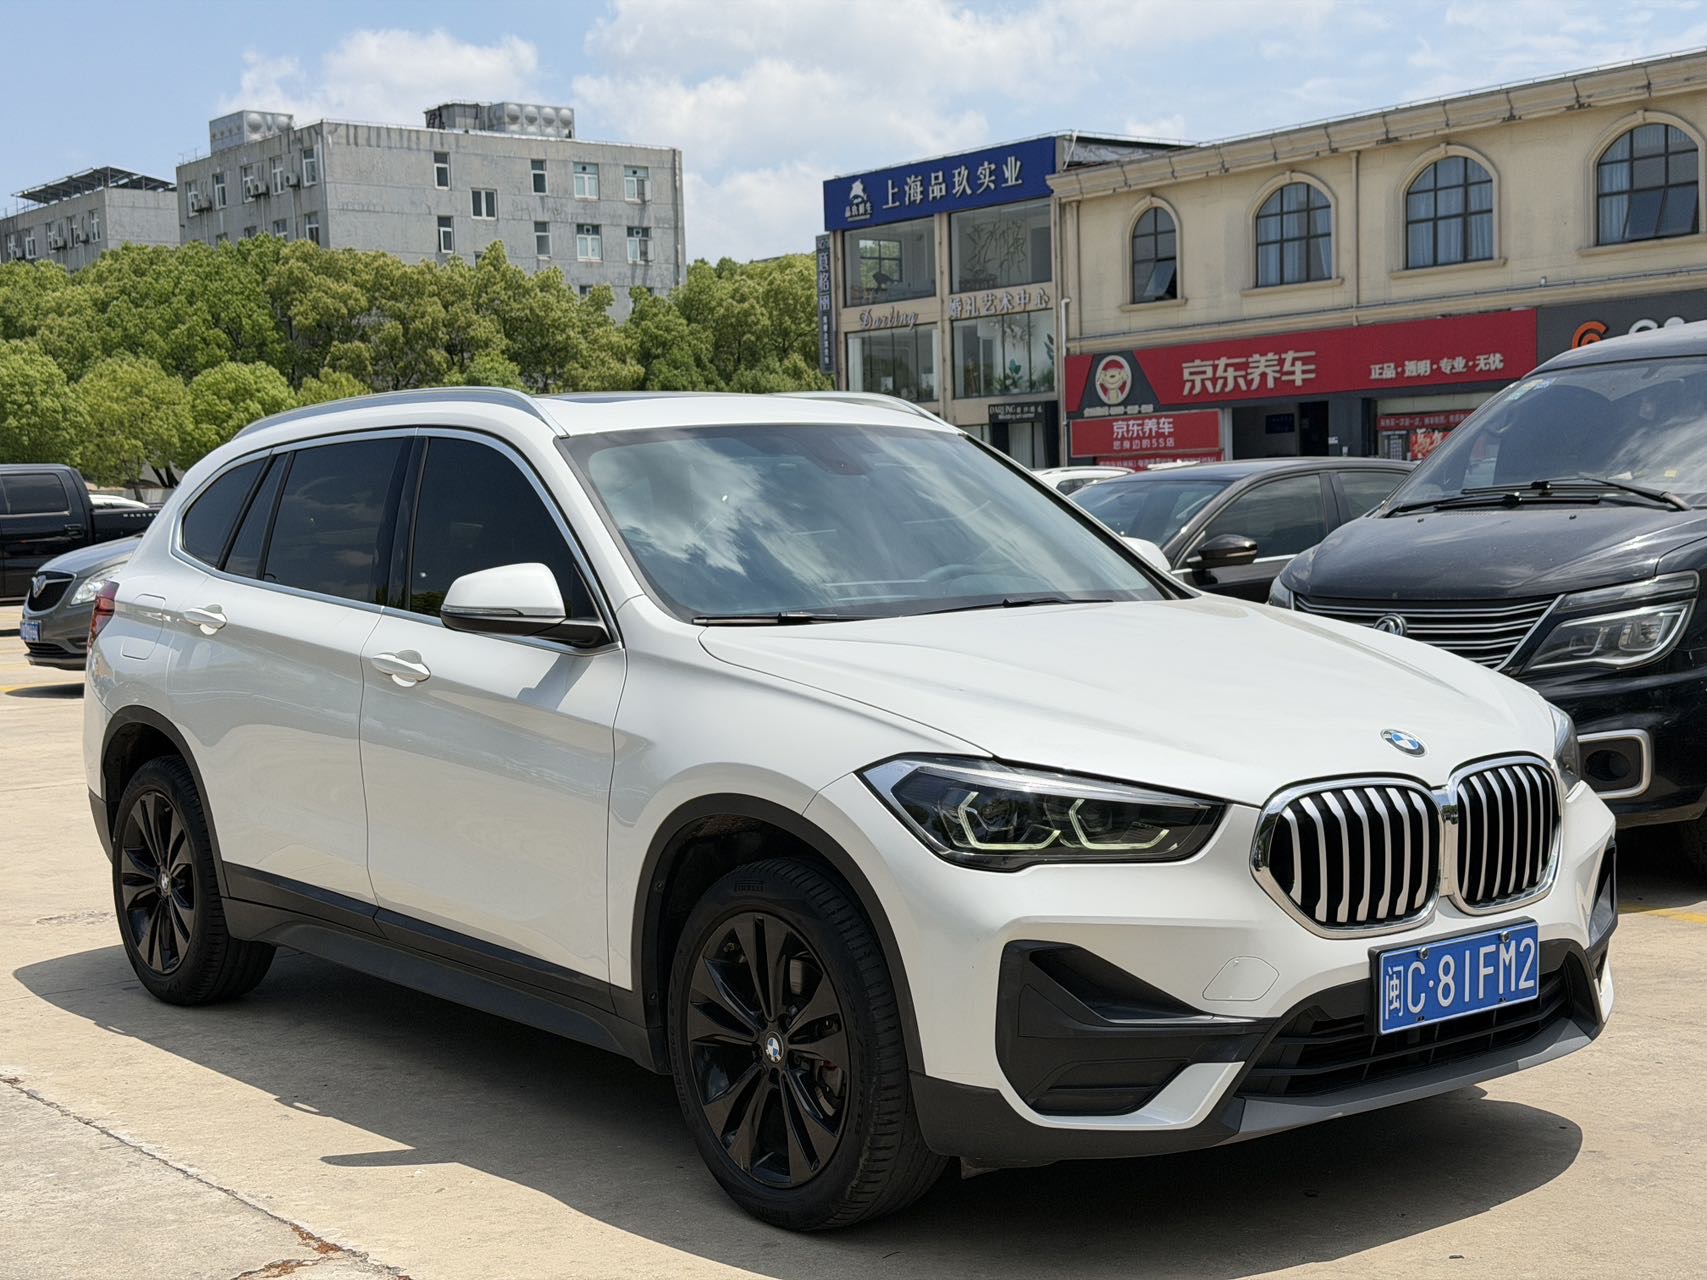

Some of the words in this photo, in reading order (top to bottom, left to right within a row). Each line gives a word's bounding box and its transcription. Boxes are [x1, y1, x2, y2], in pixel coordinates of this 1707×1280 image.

[882, 156, 1023, 208] 上海品玖实业
[949, 287, 1051, 319] 婚礼艺术中心
[1182, 350, 1317, 396] 京东养车
[1112, 417, 1175, 439] 京东养车
[1385, 937, 1535, 1020] 闽C·81FM2
